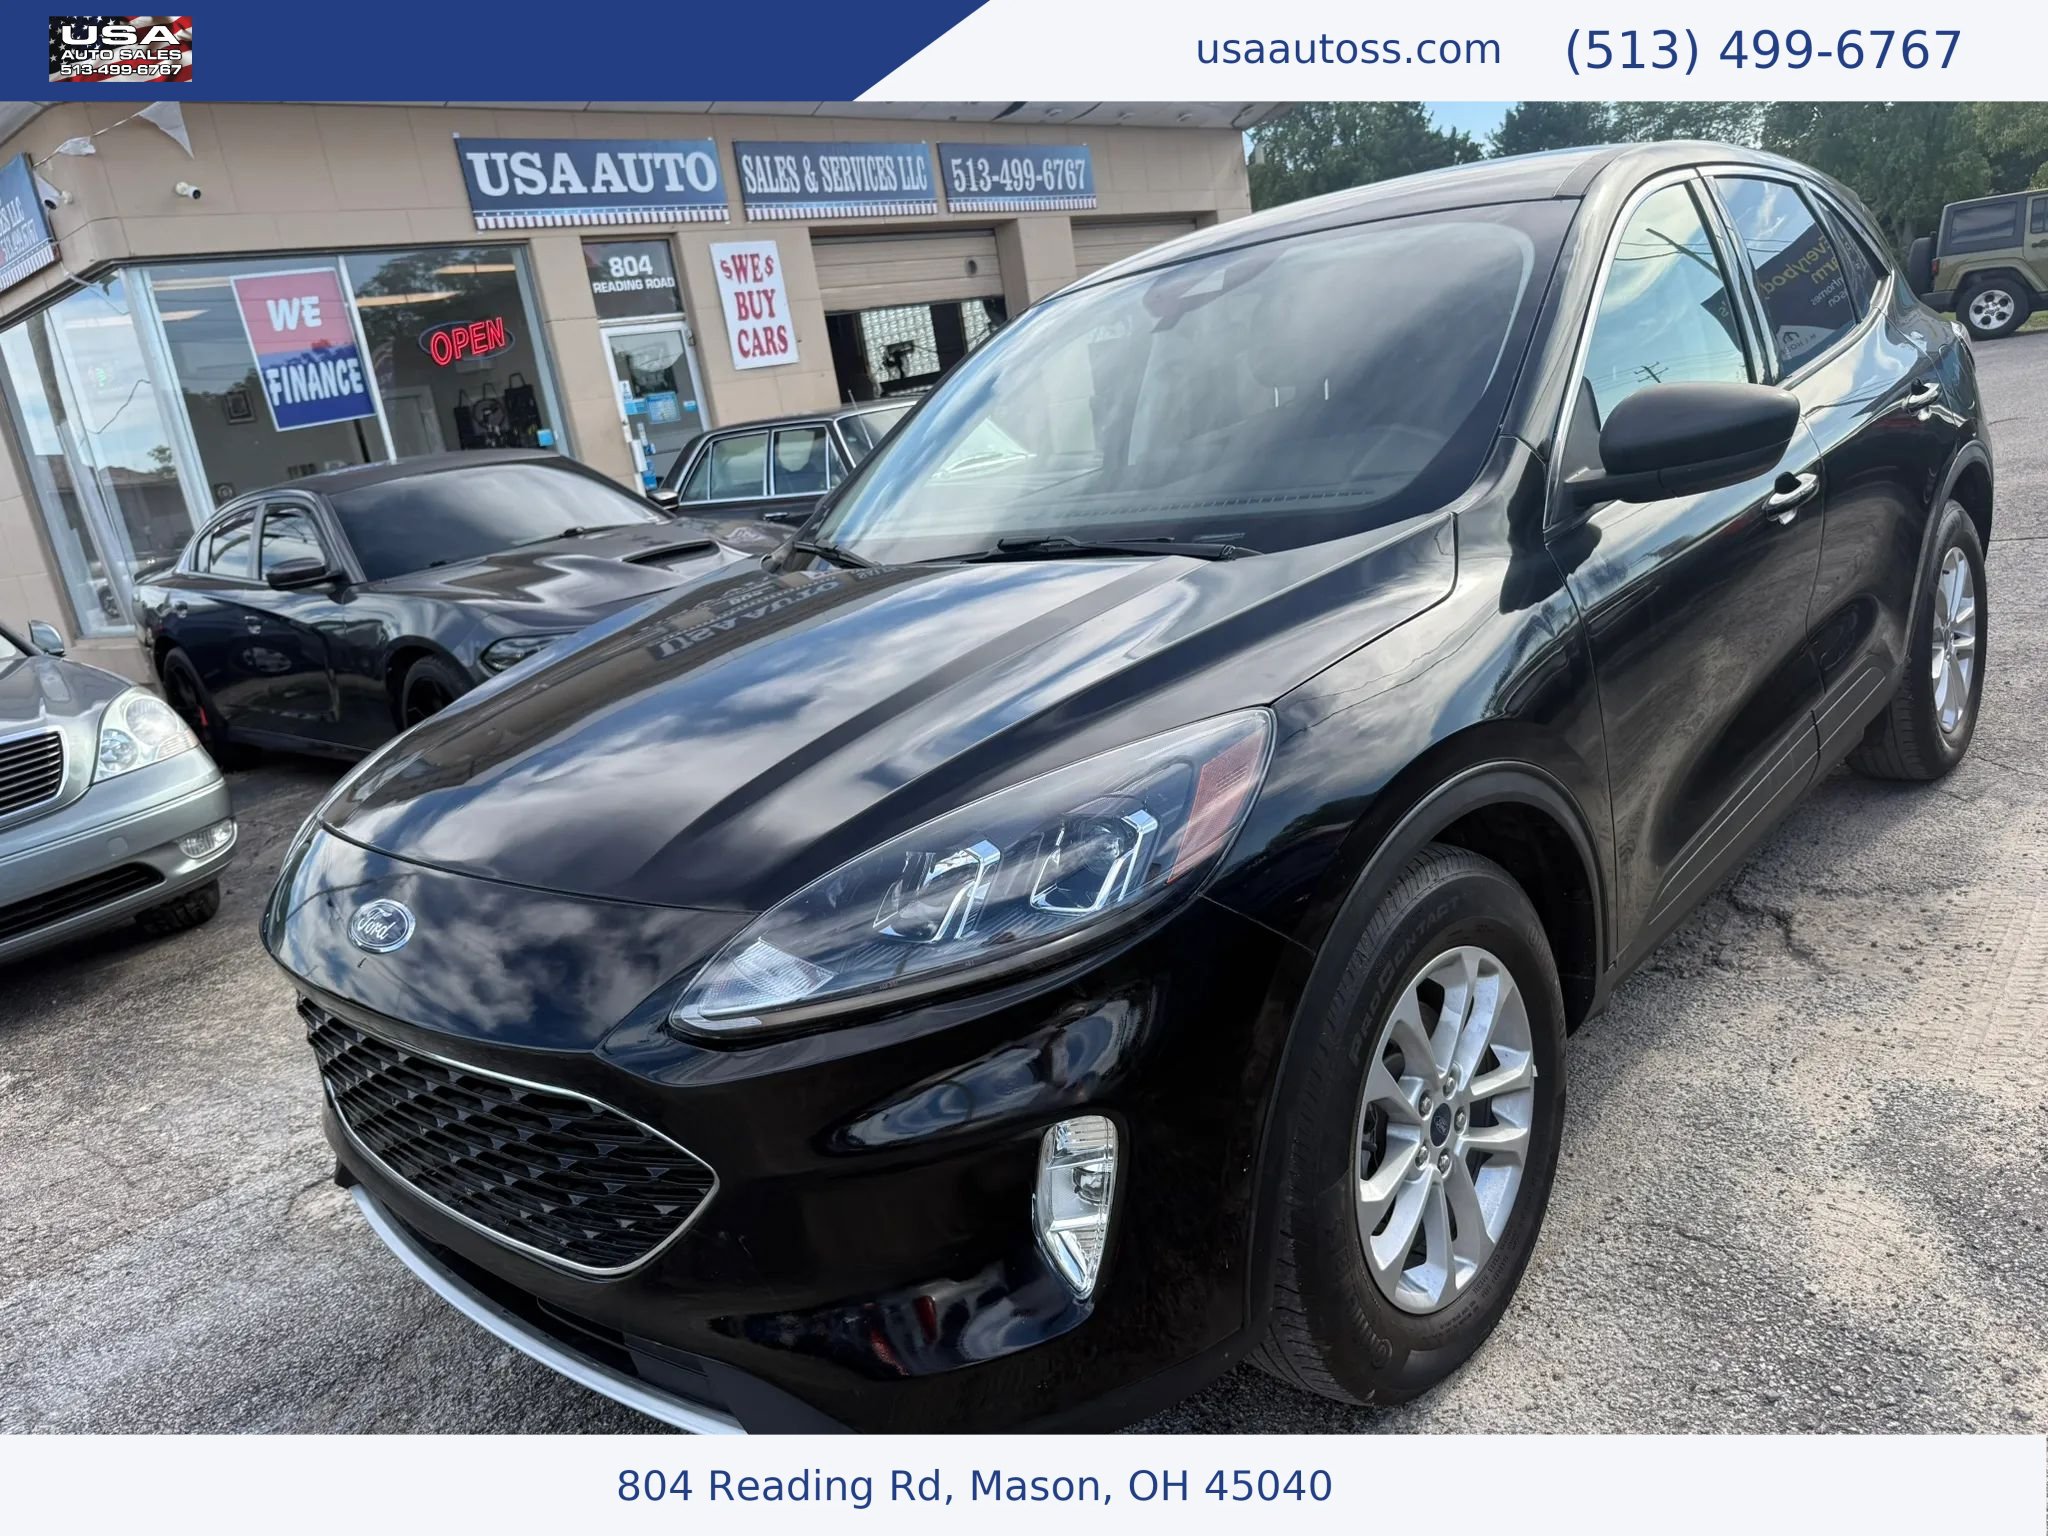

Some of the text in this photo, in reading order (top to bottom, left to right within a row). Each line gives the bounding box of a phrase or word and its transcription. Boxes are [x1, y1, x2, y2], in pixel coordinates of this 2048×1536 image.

[466, 151, 718, 197] USA AUTO
[742, 155, 928, 195] SALES & SERVICES LLC
[951, 158, 1086, 192] 513-499-6767
[608, 255, 654, 278] 804
[592, 276, 676, 294] READING ROAD
[267, 295, 323, 333] WE
[734, 289, 776, 321] BUY
[430, 317, 506, 366] OPEN
[737, 325, 789, 359] CARS
[265, 357, 365, 407] FINANCE
[357, 907, 397, 941] Ford
